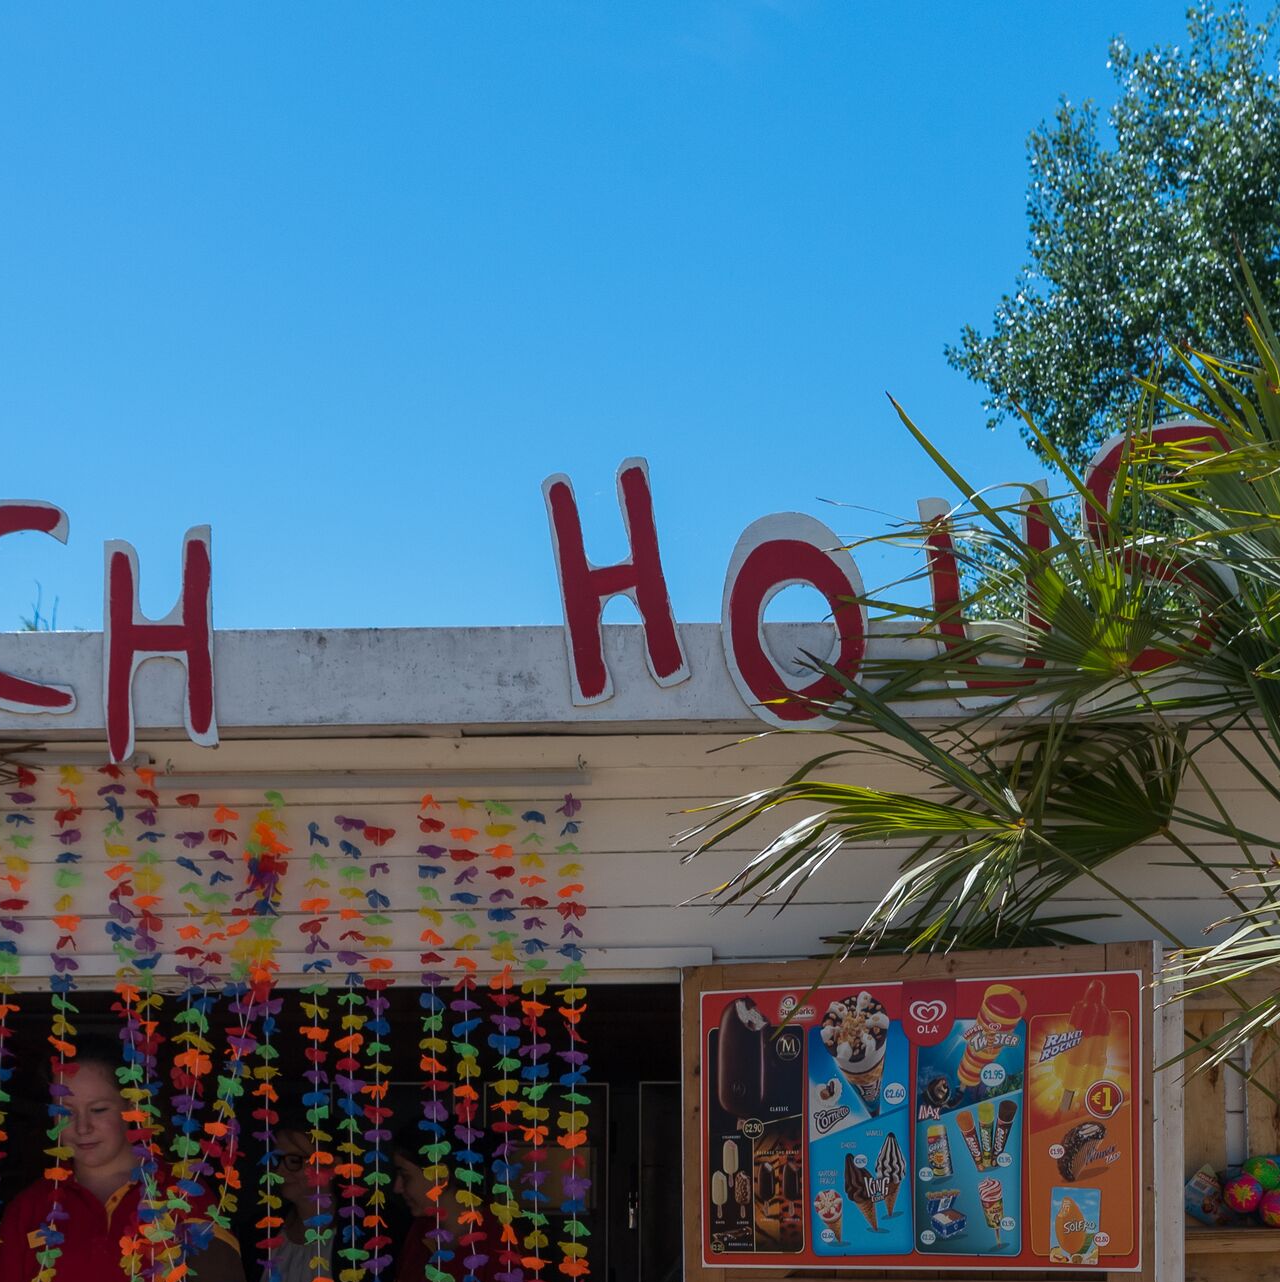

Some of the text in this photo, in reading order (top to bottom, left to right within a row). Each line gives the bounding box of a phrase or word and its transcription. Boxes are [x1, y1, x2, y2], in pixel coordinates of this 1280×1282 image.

[540, 418, 1242, 730] HOUS
[916, 1025, 939, 1034] OLA
[1044, 1029, 1083, 1049] RAKET
[1040, 1038, 1082, 1062] ROCKET
[983, 1069, 1004, 1080] €1.95
[885, 1089, 905, 1099] €2.60
[1091, 1087, 1113, 1111] €1
[917, 1104, 941, 1120] MAX
[744, 1123, 763, 1134] €2.90
[1062, 1220, 1097, 1235] SOLERO
